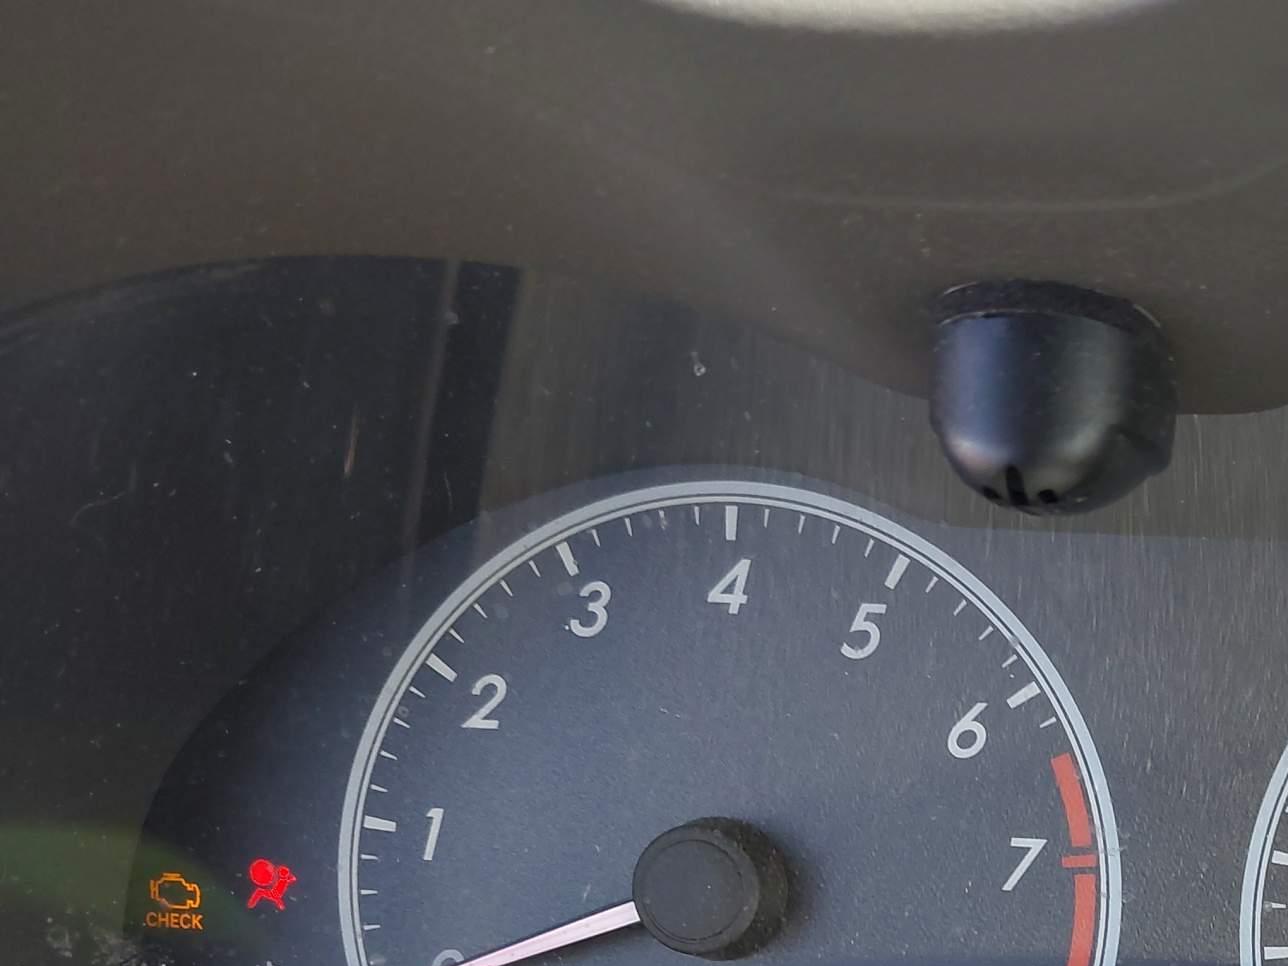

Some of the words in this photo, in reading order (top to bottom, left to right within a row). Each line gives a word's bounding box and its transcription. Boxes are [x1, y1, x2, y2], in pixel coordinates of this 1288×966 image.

[570, 582, 611, 636] 3
[707, 559, 751, 614] 4
[841, 604, 886, 659] 5
[461, 674, 506, 729] 2
[947, 703, 988, 758] 6
[423, 808, 444, 861] 1
[1002, 838, 1046, 891] 7
[146, 912, 202, 930] CHECK
